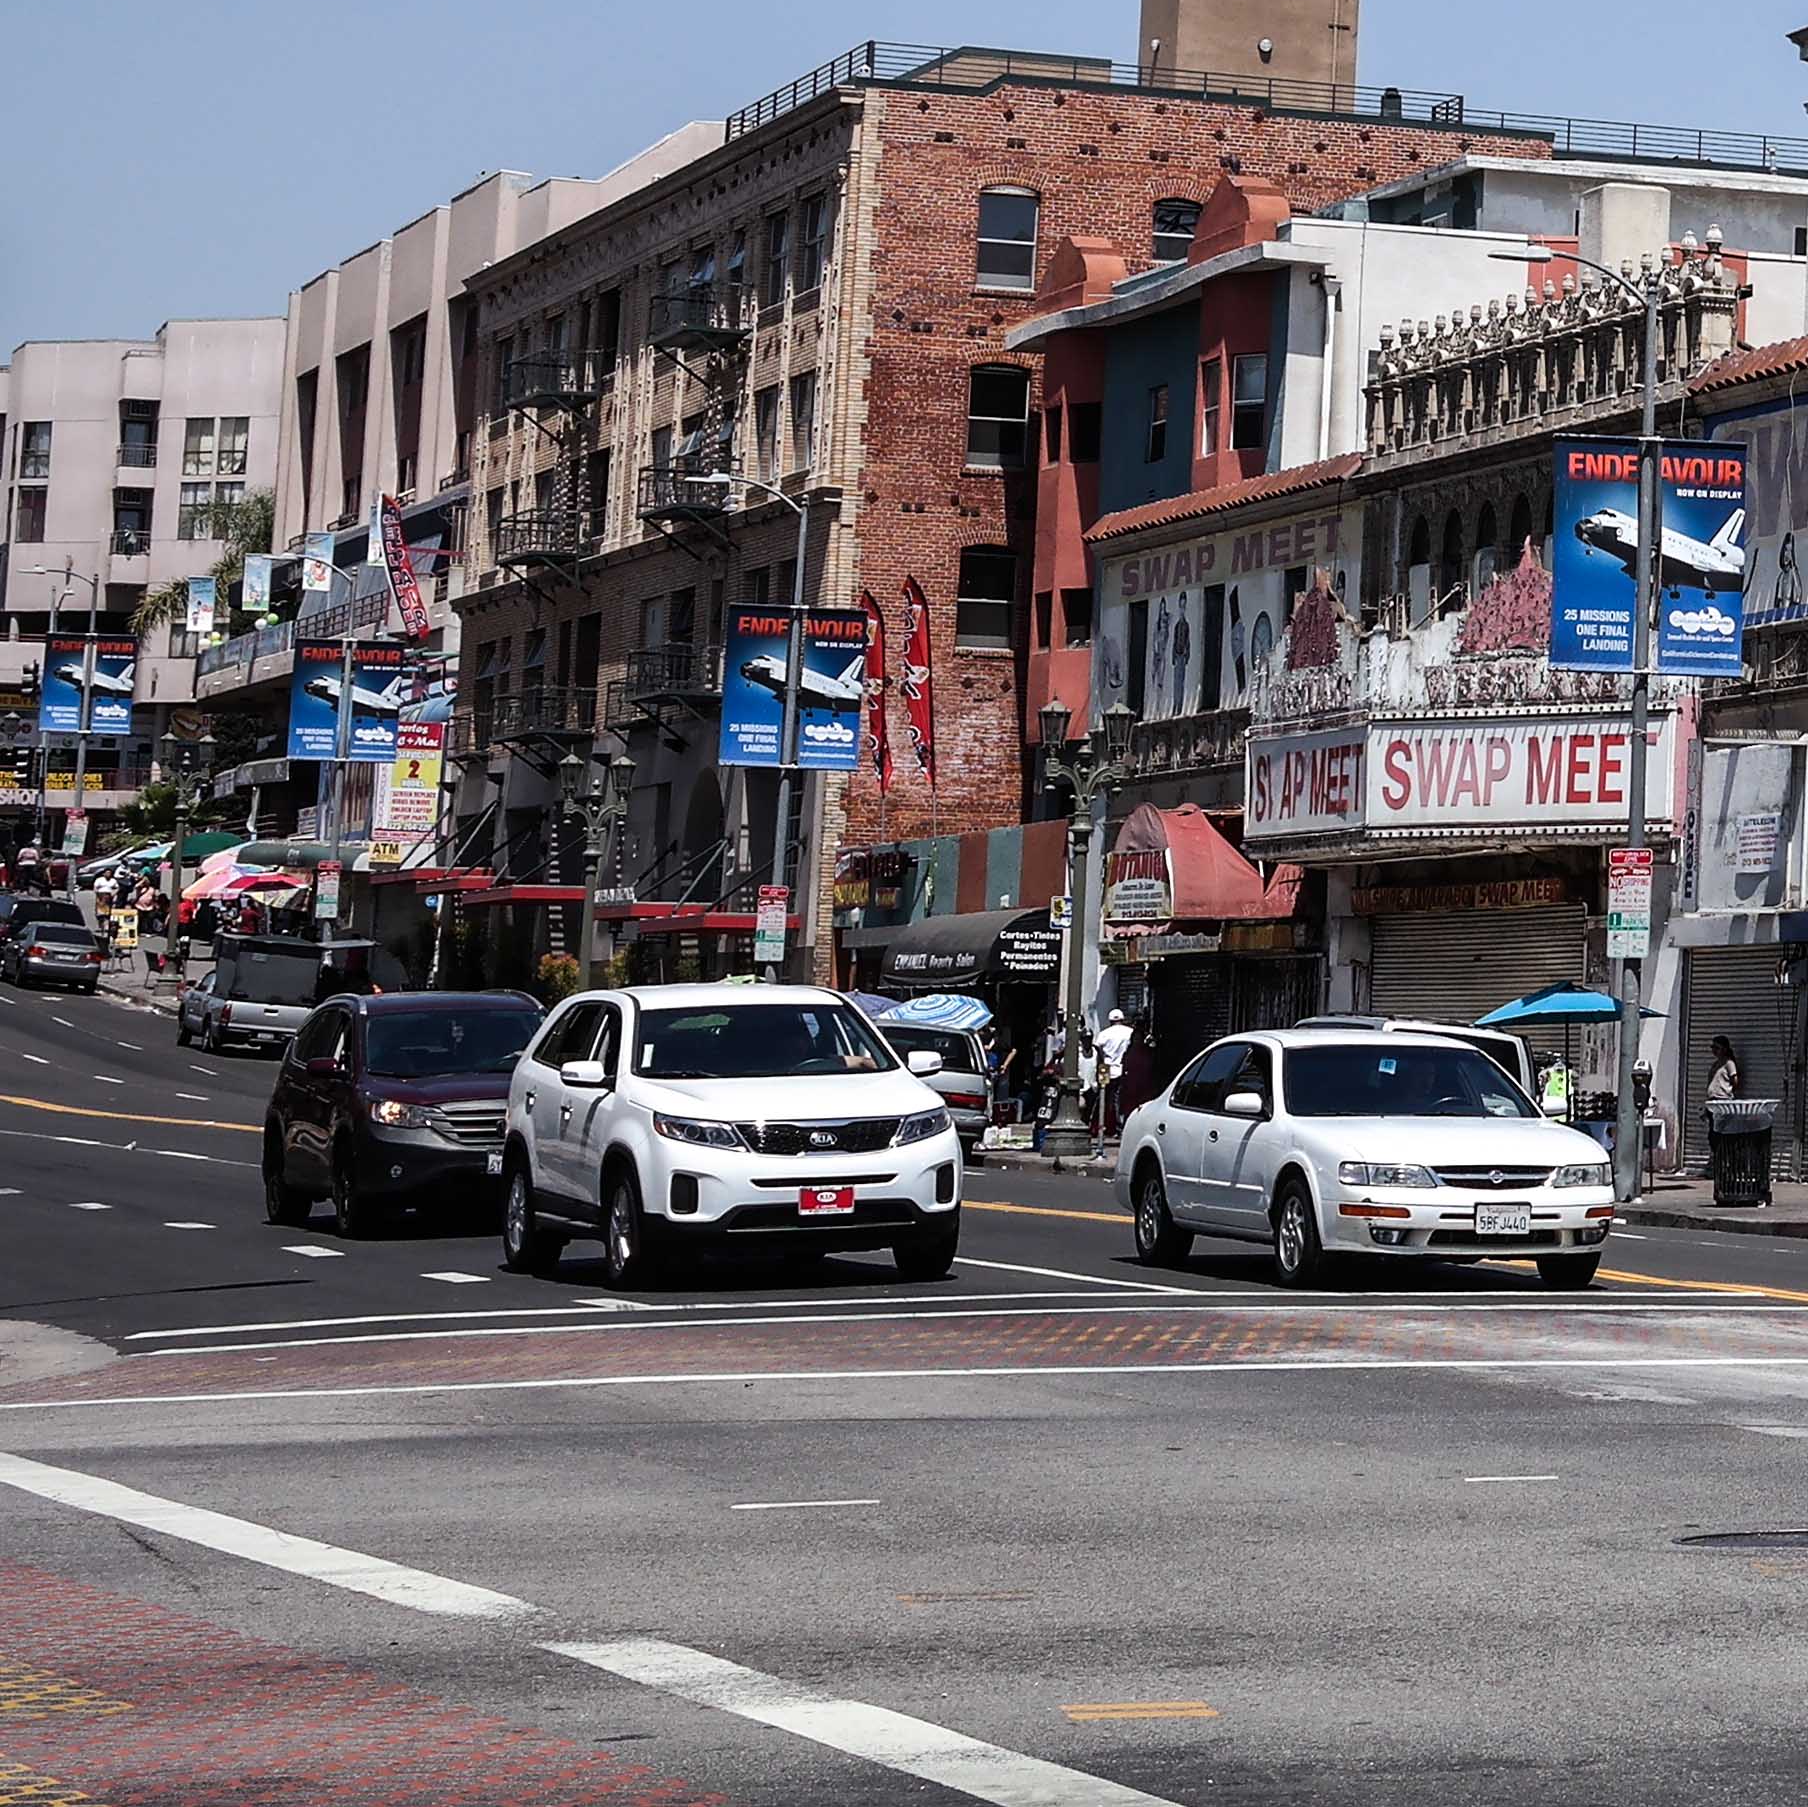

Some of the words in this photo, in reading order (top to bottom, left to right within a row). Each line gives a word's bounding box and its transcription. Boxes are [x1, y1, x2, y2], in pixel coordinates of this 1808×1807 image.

[1568, 452, 1743, 486] ENDEAVOUR
[1709, 490, 1742, 500] DISPLAY
[1121, 542, 1216, 596] SWAP
[1231, 514, 1343, 575] MEET
[1564, 609, 1577, 621] 25
[1579, 609, 1630, 622] MISSIONS
[1576, 624, 1597, 636] ONE
[1599, 625, 1629, 637] FINAL
[1583, 638, 1628, 652] LANDING
[408, 760, 420, 778] 2
[1381, 737, 1513, 812] SWAP
[1308, 742, 1364, 816] MEET
[372, 843, 399, 855] ATM
[1013, 941, 1047, 951] Rayitos
[1000, 951, 1058, 961] Permanentes
[814, 1134, 833, 1143] KIA
